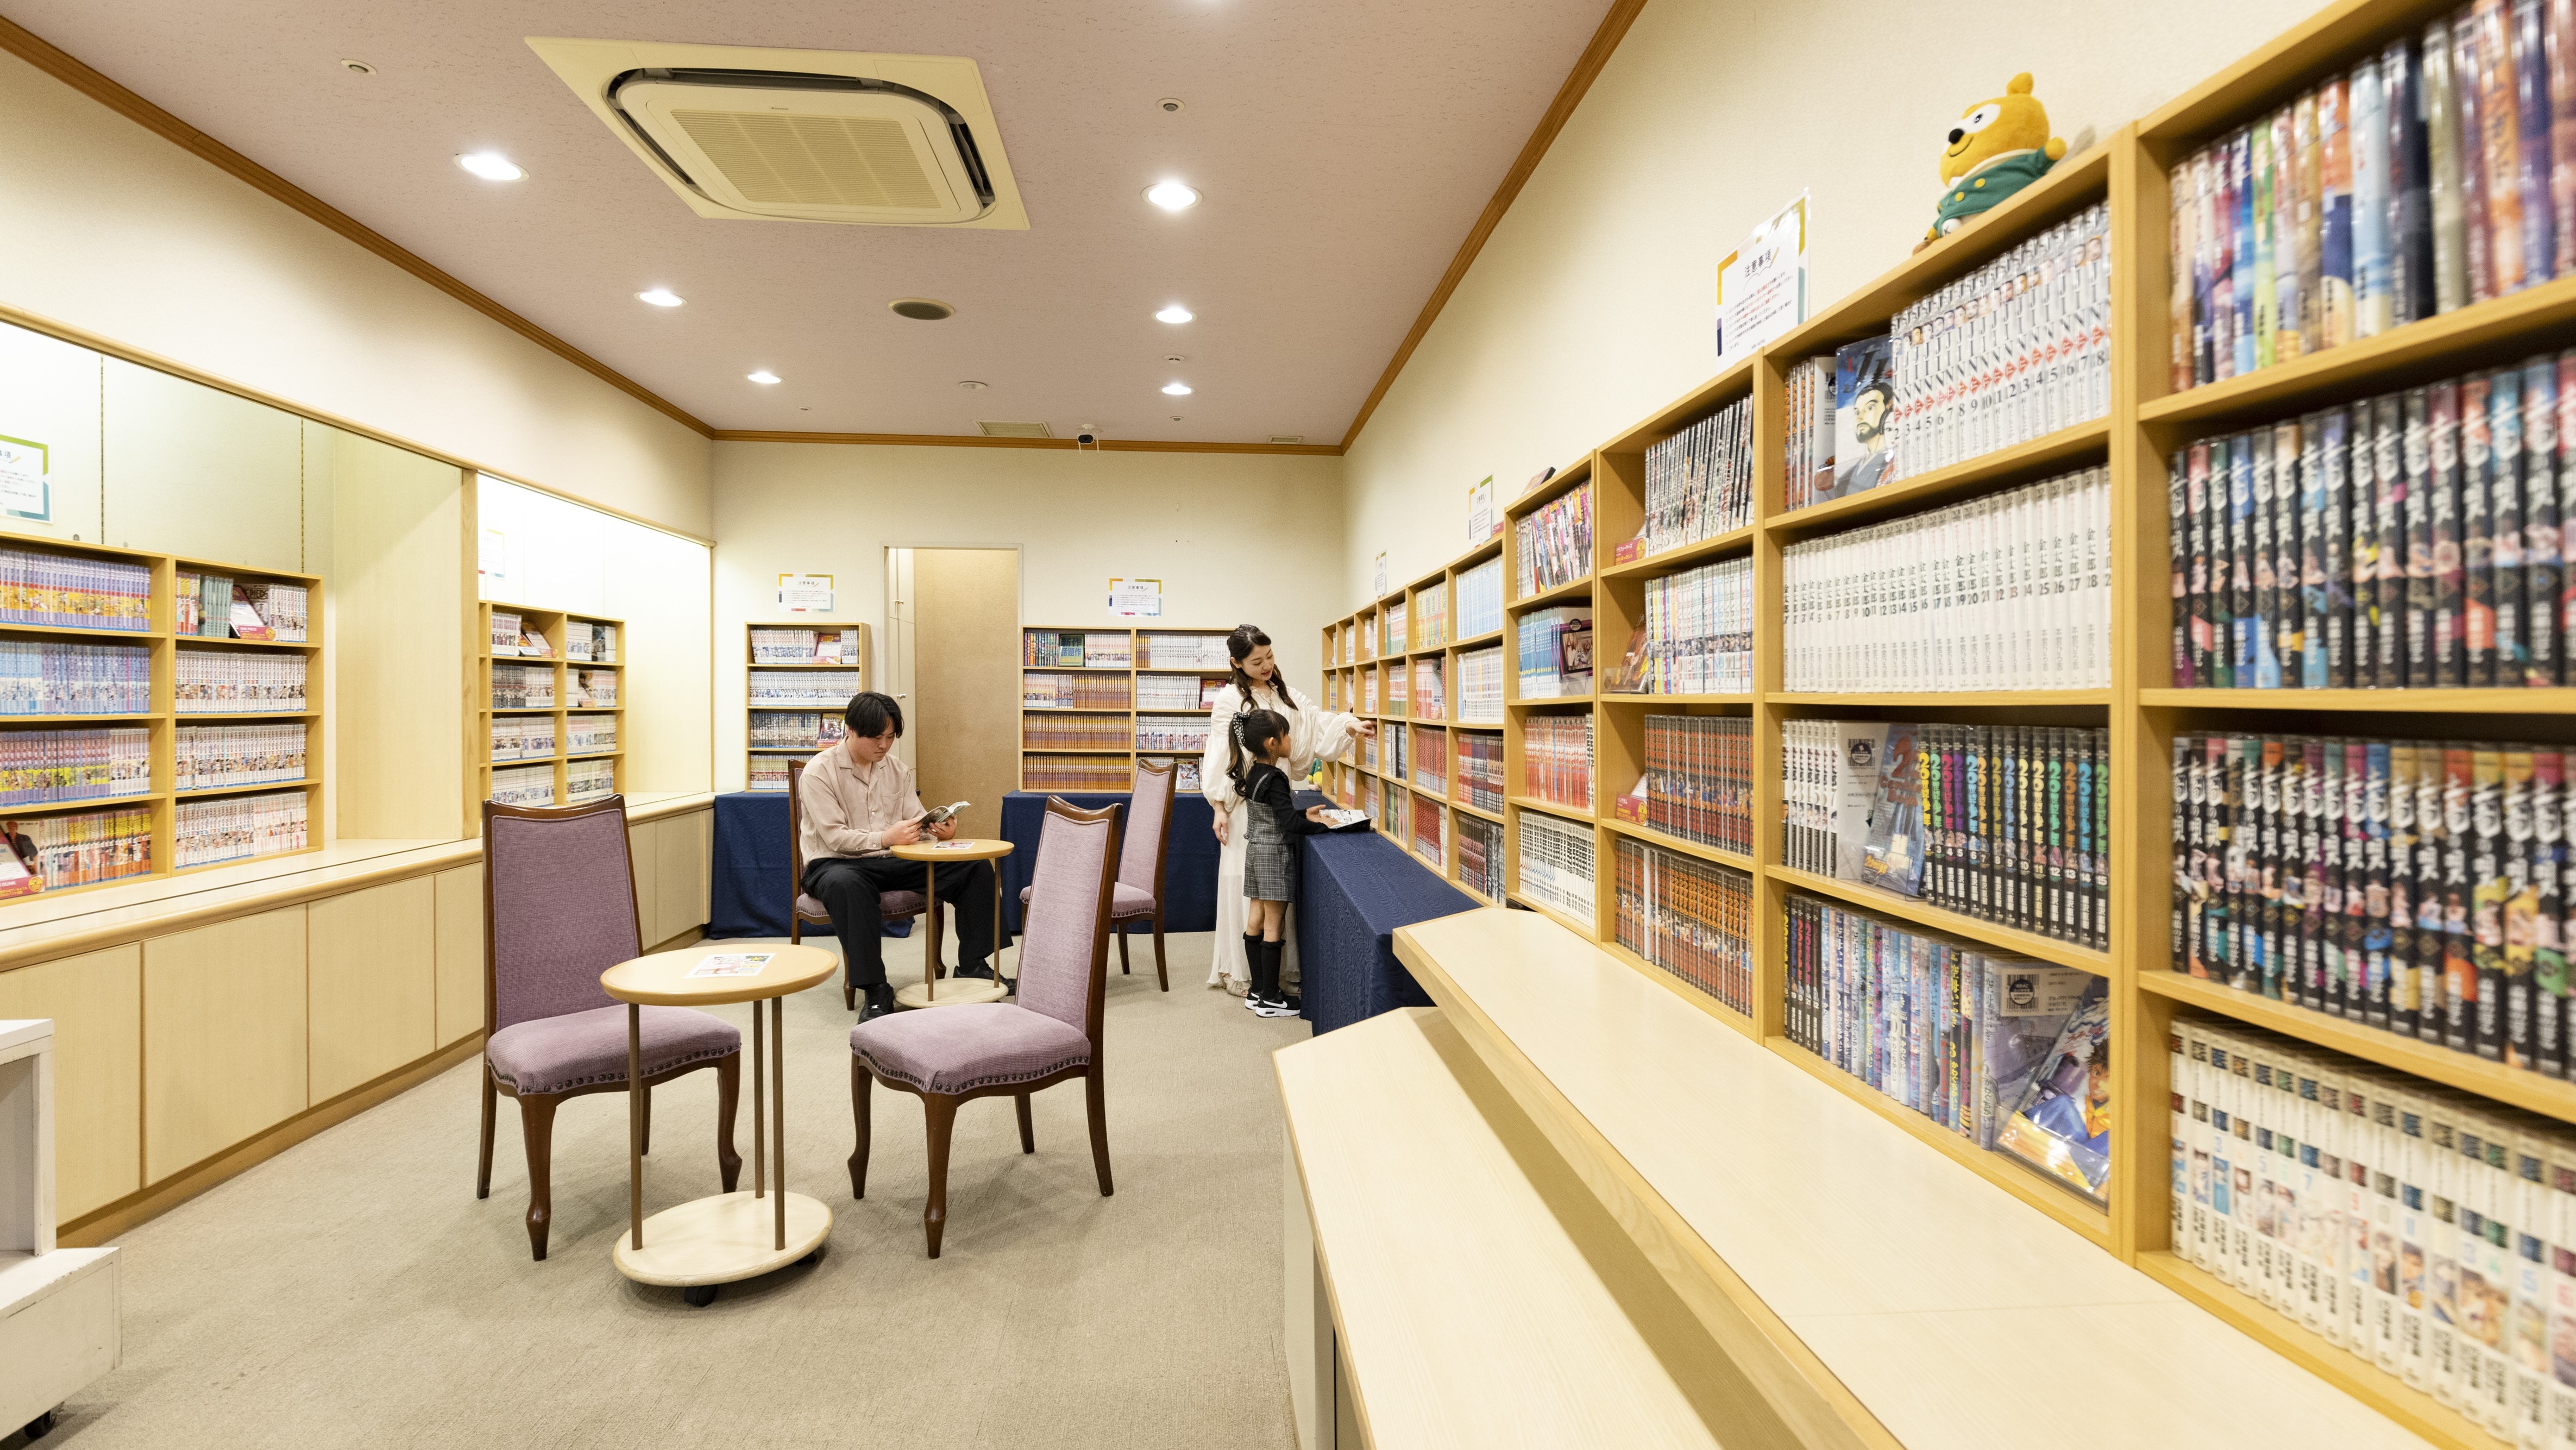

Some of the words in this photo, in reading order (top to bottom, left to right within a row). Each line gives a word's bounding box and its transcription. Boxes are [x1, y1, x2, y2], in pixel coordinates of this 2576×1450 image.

[1745, 249, 1771, 278] 注意事項
[1959, 403, 1965, 417] 8
[1971, 399, 1978, 413] 9
[1938, 412, 1944, 426] 6
[1947, 407, 1953, 420] 7
[1915, 419, 1921, 431] 4
[1926, 416, 1932, 429] 5
[1894, 428, 1900, 440] 2
[1906, 424, 1911, 436] 3
[2040, 582, 2050, 595] 25
[2054, 580, 2064, 594] 26
[2070, 578, 2081, 591] 27
[1956, 594, 1966, 606] 19
[1968, 593, 1978, 605] 20
[1983, 590, 1989, 602] 21
[1890, 604, 1896, 614] 13
[1899, 602, 1906, 613] 14
[1910, 601, 1918, 613] 15
[1934, 598, 1941, 609] 17
[1845, 609, 1850, 619] 8
[1862, 607, 1870, 617] 10
[1880, 605, 1887, 616] 12
[1802, 614, 1806, 623] 3
[1818, 613, 1821, 623] 5
[1061, 638, 1082, 647] 新作
[1061, 648, 1082, 657] 話題作
[1953, 754, 1964, 831] 20世紀少年
[1966, 755, 1978, 833] 20世紀少年
[1977, 757, 1987, 836] 20世紀少年
[1992, 757, 2002, 836] 20世紀少年
[2004, 758, 2015, 838] 20世紀少年
[1919, 752, 1931, 826] 20世紀少年
[1926, 843, 1931, 851] 2
[1930, 753, 1942, 828] 20世紀少年
[1936, 845, 1942, 853] 3
[1941, 754, 1953, 830] 20世紀少年
[1947, 848, 1953, 856] 4
[2019, 758, 2028, 842] 20世紀少年
[2033, 759, 2045, 845] 20世紀少年
[2049, 761, 2062, 846] 20世紀少年
[2065, 761, 2077, 848] 20世紀少年
[2078, 762, 2092, 851] 20世紀少年
[2095, 764, 2109, 855] 20世紀少年
[1957, 848, 1963, 857] 5
[1971, 851, 1977, 859] 6
[1981, 854, 1986, 863] 7
[1995, 856, 2001, 864] 8
[2007, 858, 2013, 868] 9
[2020, 861, 2029, 870] 10
[2035, 864, 2043, 873] 11
[2051, 867, 2060, 876] 12
[2065, 869, 2076, 879] 13
[2081, 872, 2091, 882] 14
[2097, 876, 2107, 886] 15
